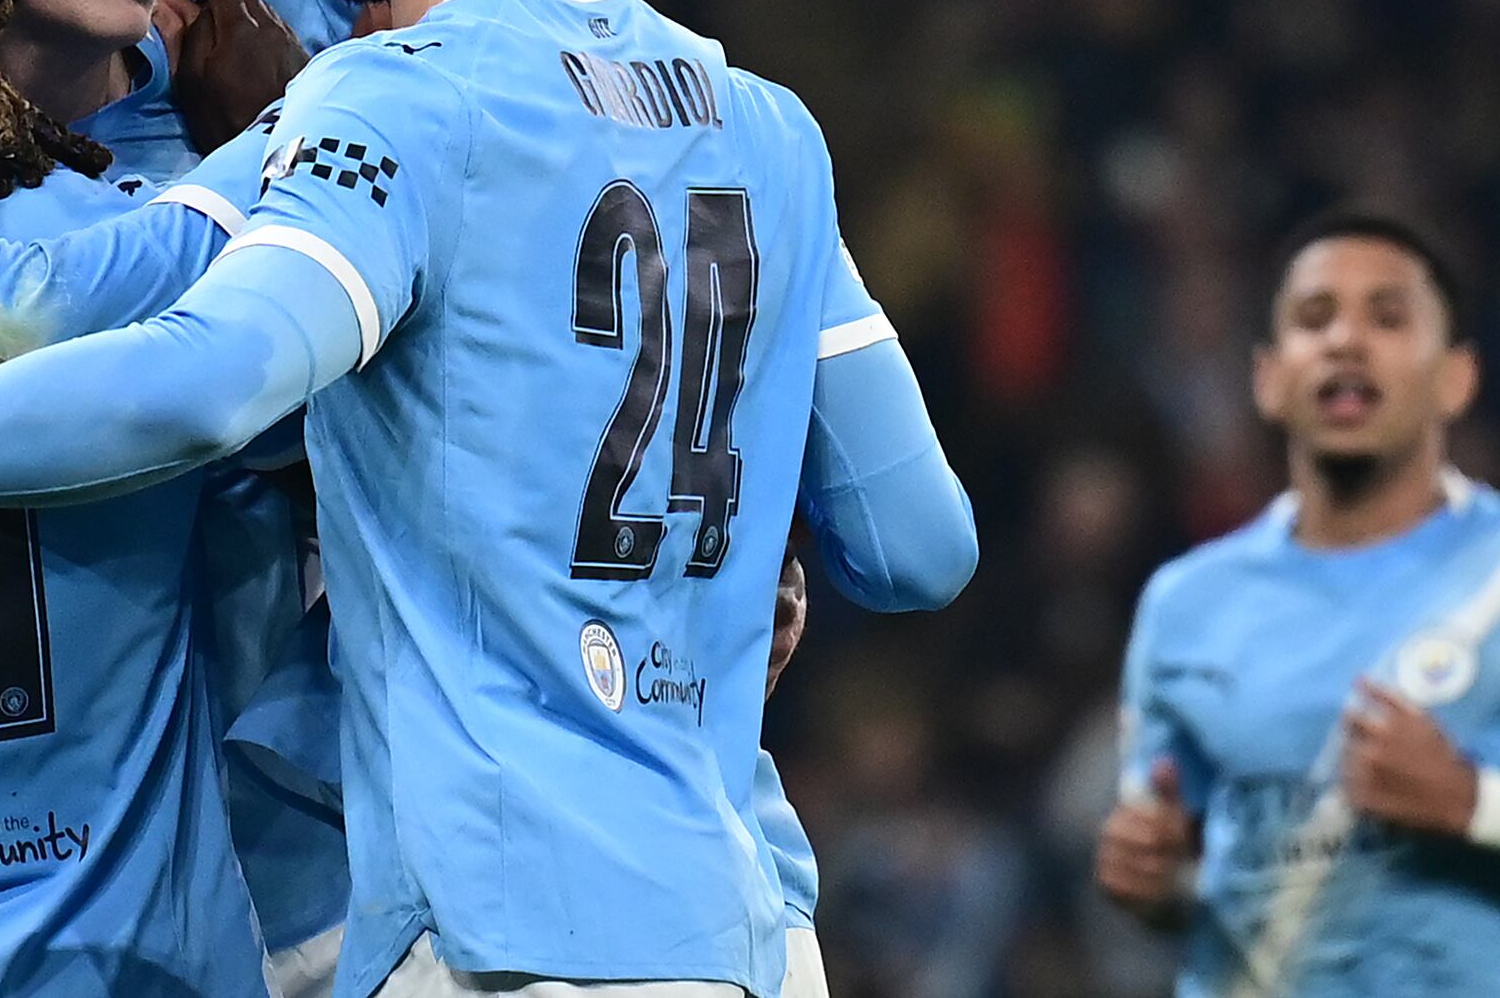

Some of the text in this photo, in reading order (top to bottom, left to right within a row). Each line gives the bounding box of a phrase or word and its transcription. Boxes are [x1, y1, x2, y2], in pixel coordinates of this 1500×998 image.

[559, 51, 724, 130] GRDIOL
[570, 178, 760, 580] 24
[4, 815, 30, 832] the
